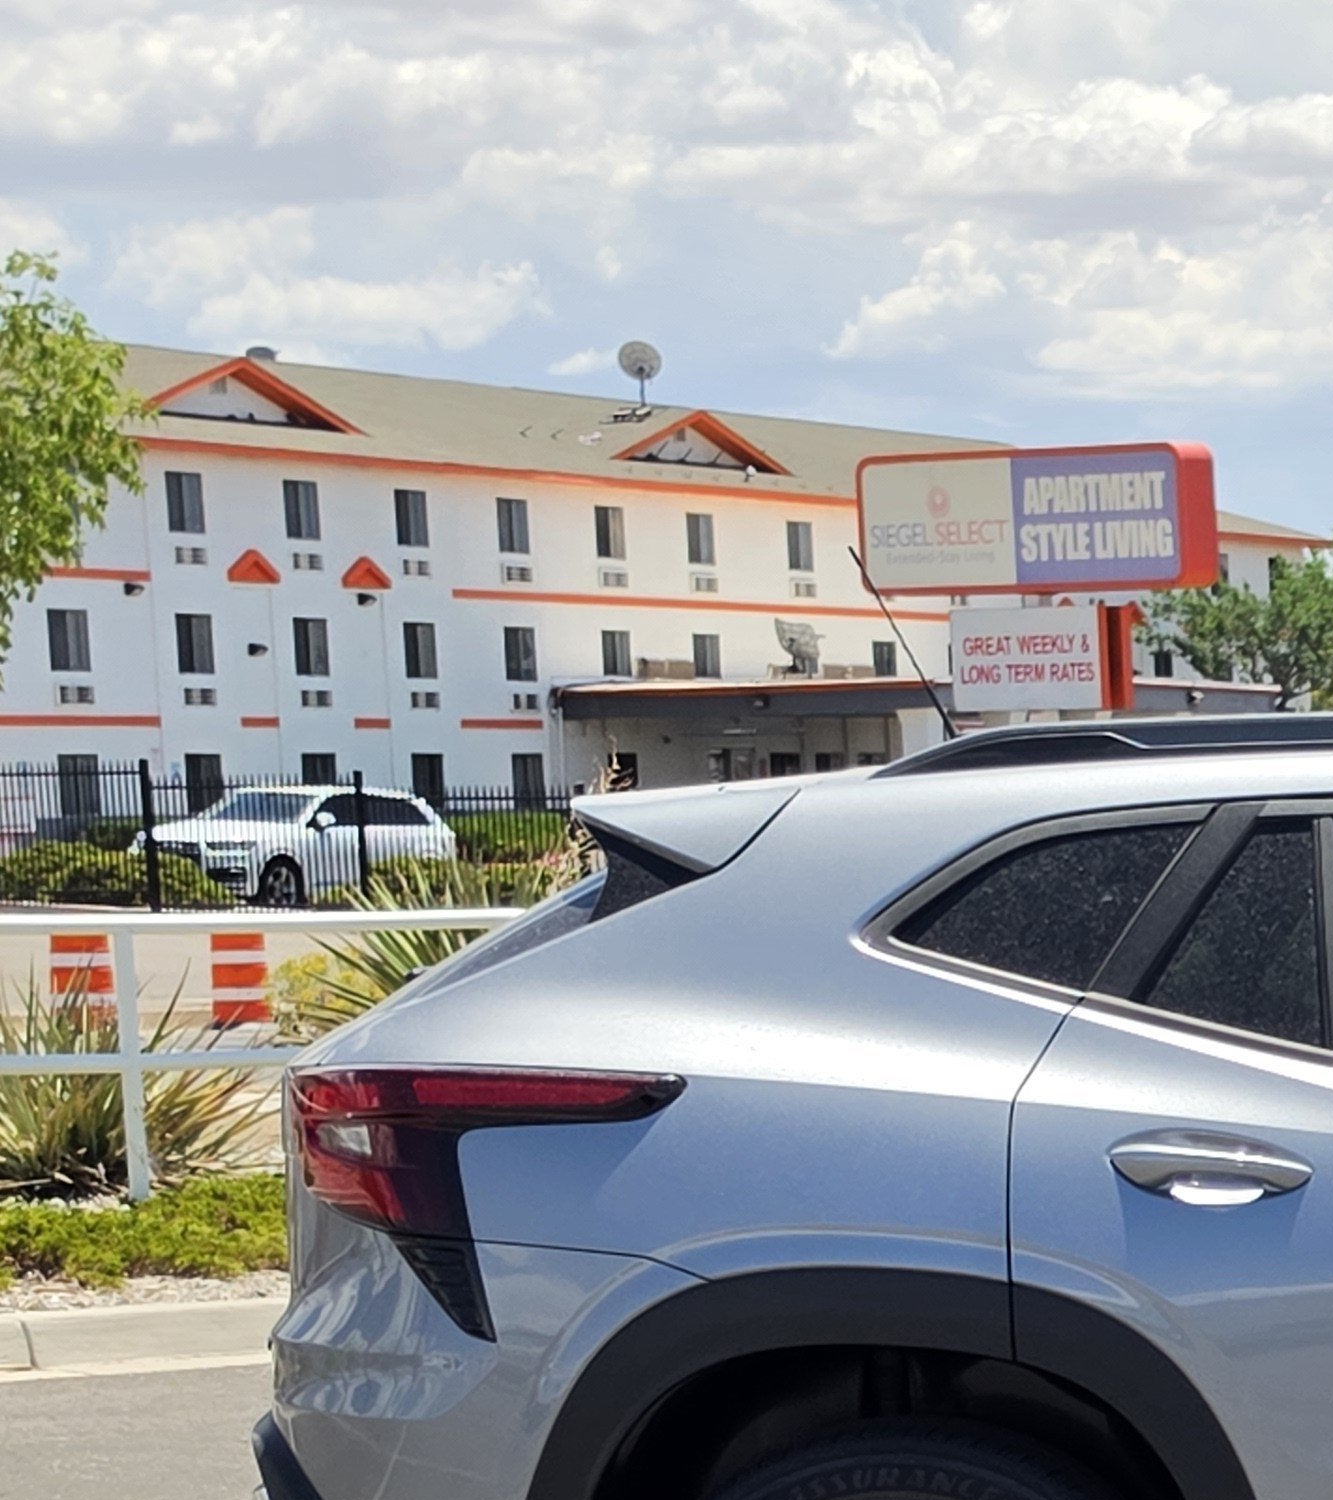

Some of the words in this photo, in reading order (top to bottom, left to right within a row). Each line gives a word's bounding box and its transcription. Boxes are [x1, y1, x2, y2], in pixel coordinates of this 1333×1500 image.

[1023, 471, 1166, 515] APARTMENT
[870, 523, 933, 548] SIEGEL
[934, 519, 1010, 545] SELECT
[1020, 522, 1091, 562] STYLE
[1094, 518, 1174, 559] LIVING
[962, 636, 1012, 657] GREAT
[1017, 634, 1075, 656] WEEKLY
[1081, 633, 1090, 653] &
[960, 664, 1002, 685] LONG
[1005, 663, 1045, 683] TERM
[1050, 662, 1095, 683] RATES
